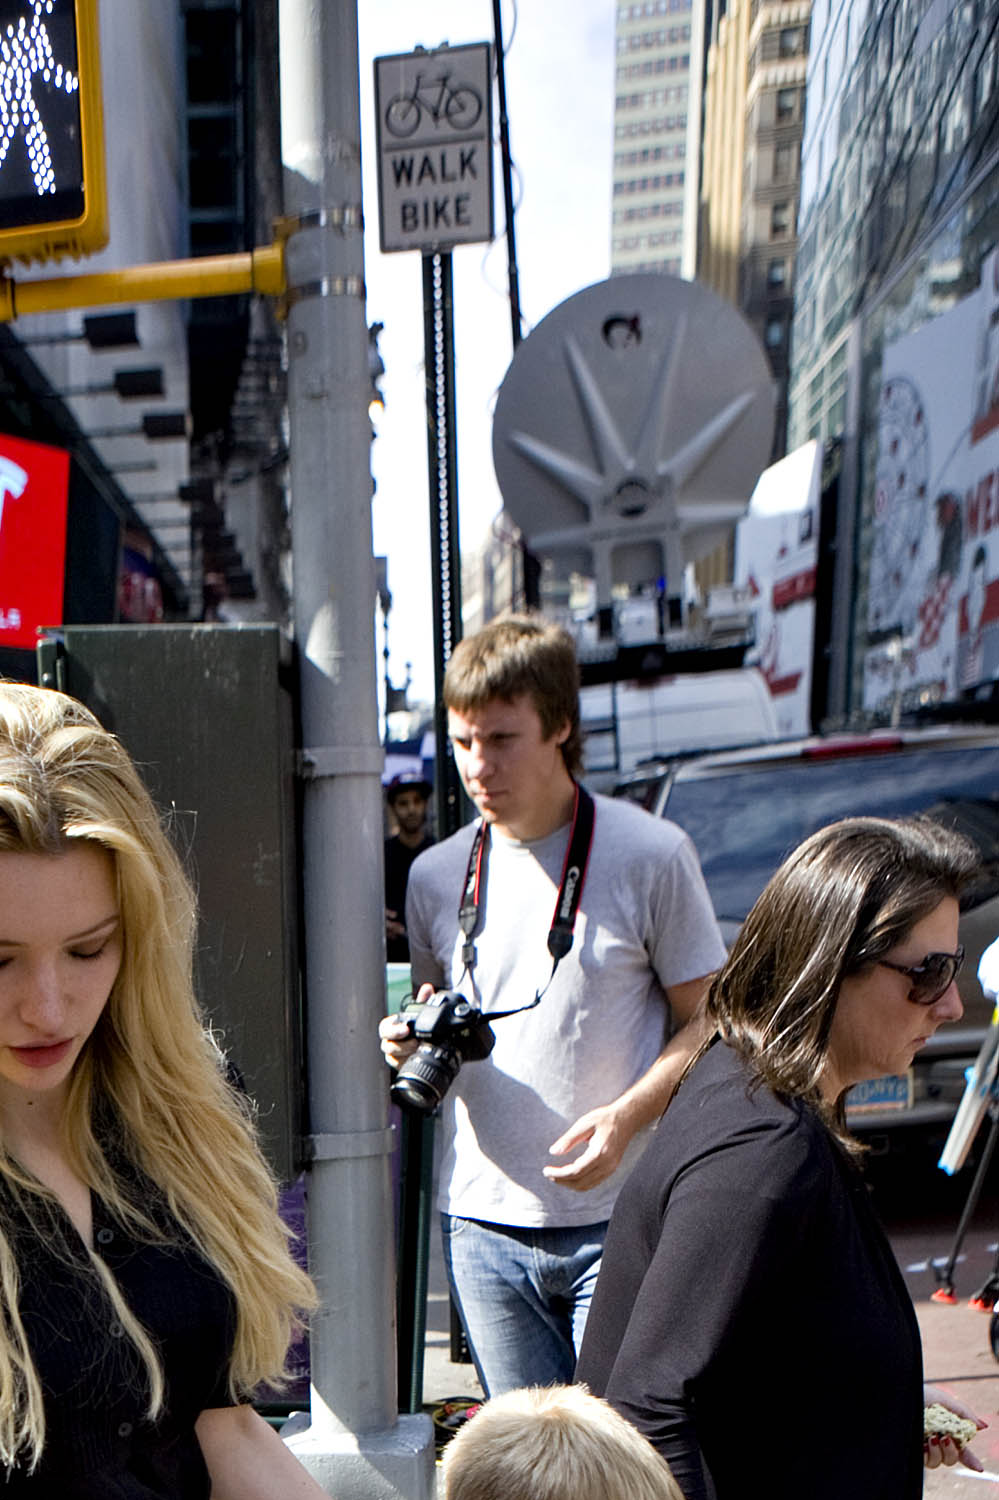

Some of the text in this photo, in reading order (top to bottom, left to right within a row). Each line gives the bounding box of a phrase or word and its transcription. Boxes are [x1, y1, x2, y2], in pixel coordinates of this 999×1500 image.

[392, 148, 477, 188] WALK
[401, 194, 471, 232] BIKE
[560, 865, 580, 918] Canon
